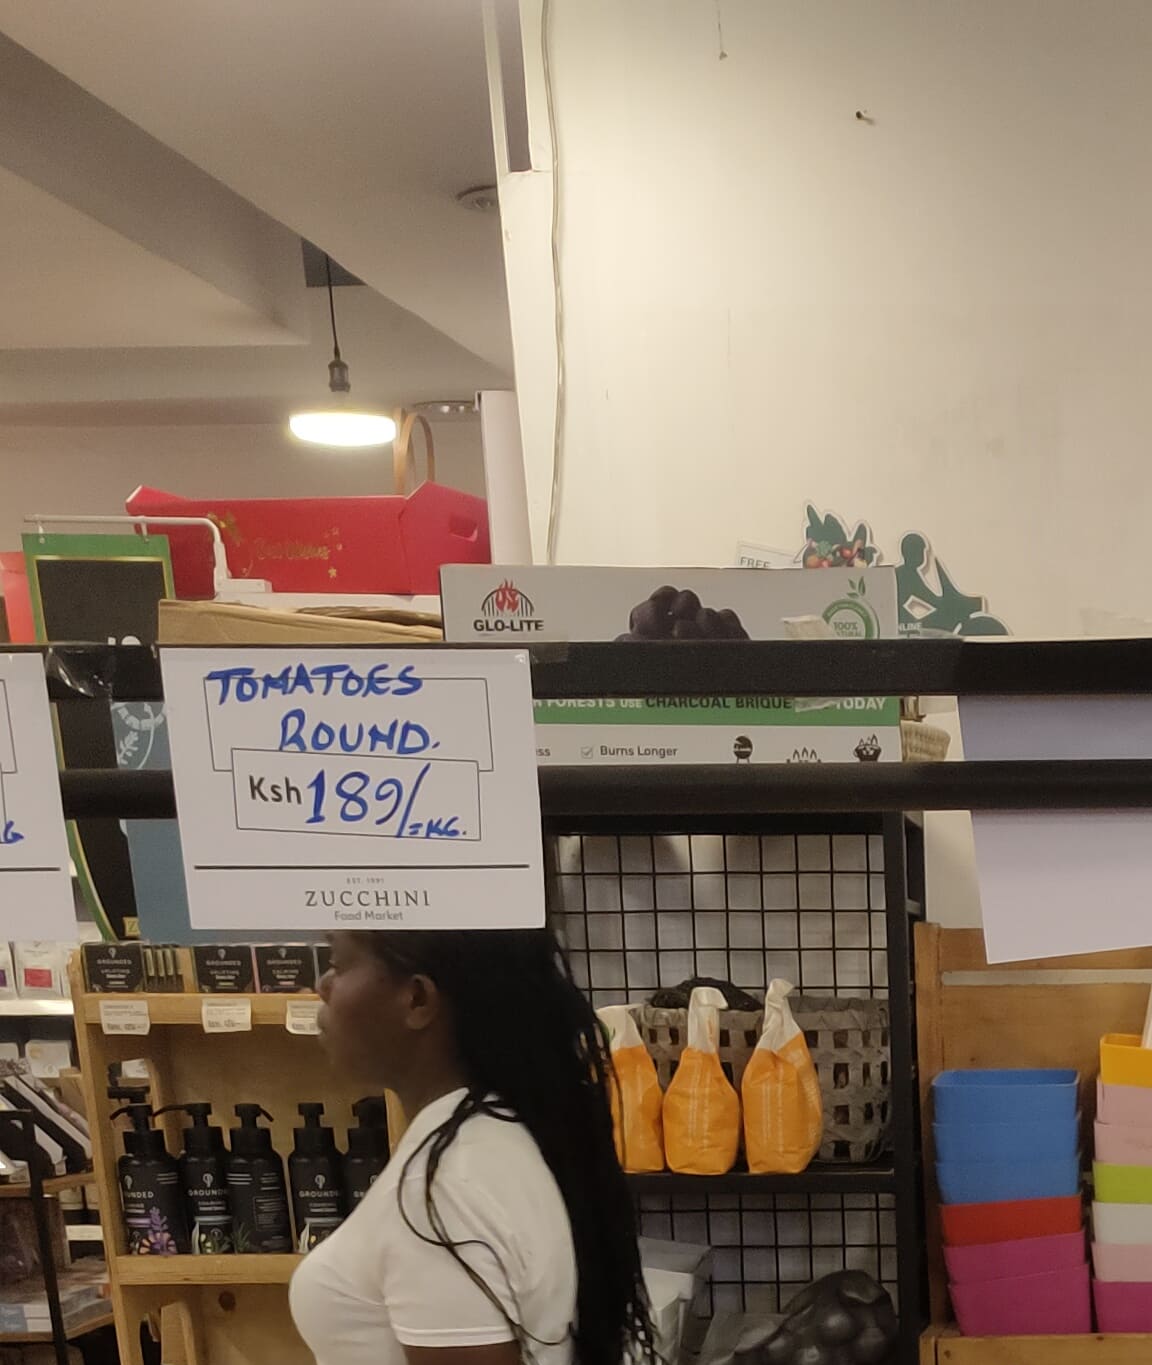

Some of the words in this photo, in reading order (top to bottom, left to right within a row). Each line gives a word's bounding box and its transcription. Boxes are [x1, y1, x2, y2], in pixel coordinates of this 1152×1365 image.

[473, 620, 544, 632] GLO-LITE
[205, 663, 423, 705] TOMATOES
[600, 745, 634, 757] Burns
[638, 746, 678, 759] Longer
[249, 775, 302, 804] Ksh
[304, 890, 430, 907] ZUCCHINI
[334, 910, 361, 921] Food
[364, 910, 403, 921] Market
